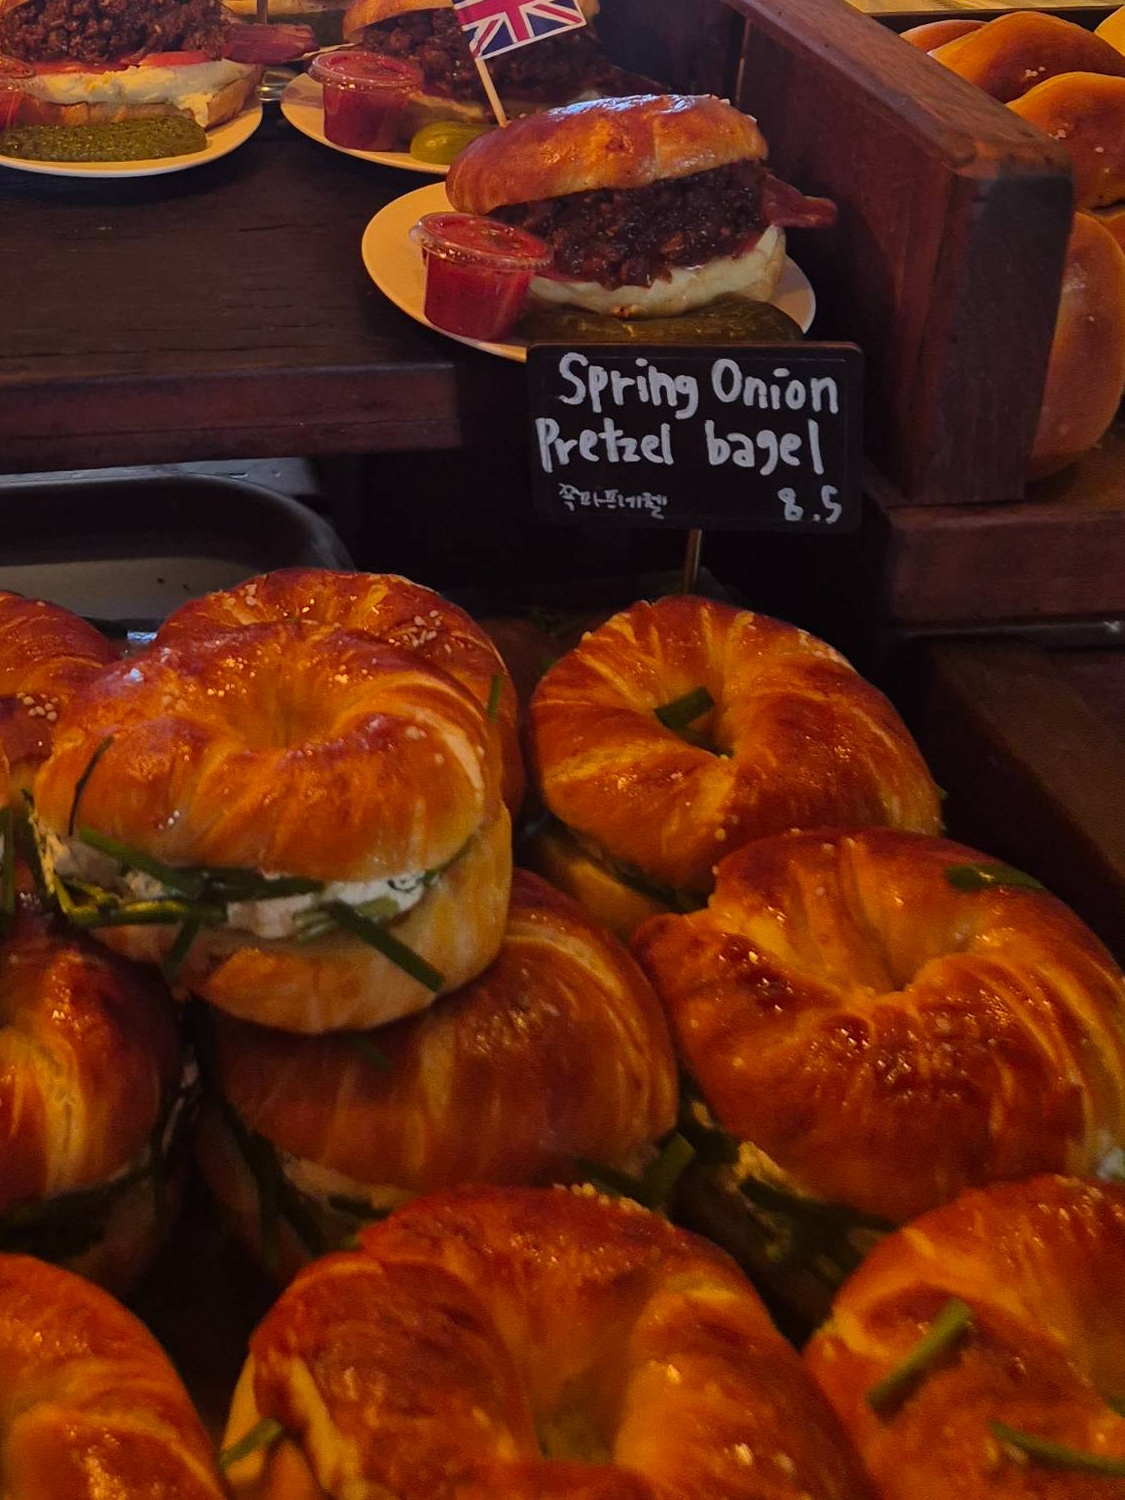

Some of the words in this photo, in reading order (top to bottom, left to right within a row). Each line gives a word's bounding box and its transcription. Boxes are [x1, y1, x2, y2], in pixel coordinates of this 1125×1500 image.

[558, 352, 699, 420] Spring
[711, 358, 839, 415] Onion
[535, 417, 675, 474] Pretzel
[704, 418, 825, 477] bagel
[777, 484, 842, 524] 8.5
